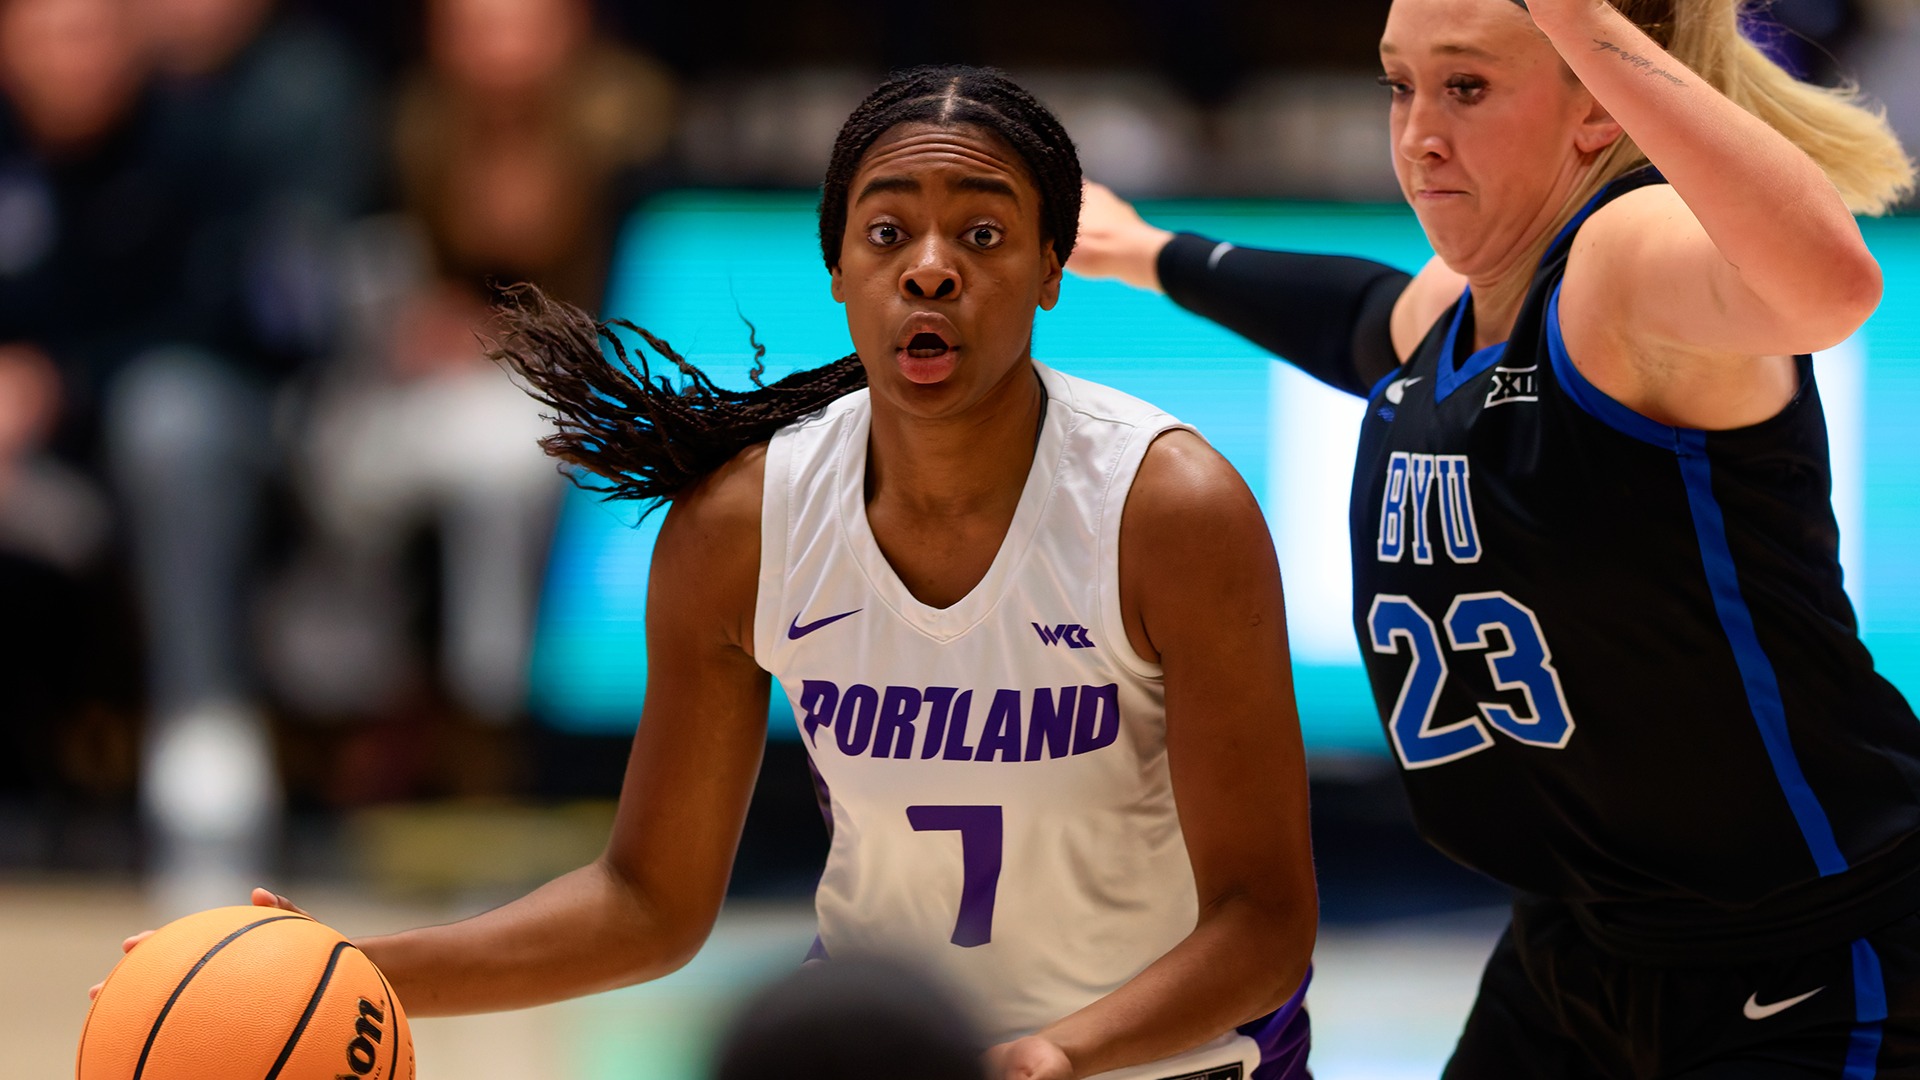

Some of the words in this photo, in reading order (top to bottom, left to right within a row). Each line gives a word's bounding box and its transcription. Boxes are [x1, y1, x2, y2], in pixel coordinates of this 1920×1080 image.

[1378, 452, 1482, 565] BYU
[800, 679, 1120, 762] PORTLAND
[1368, 591, 1576, 770] 23
[905, 805, 1003, 948] 7
